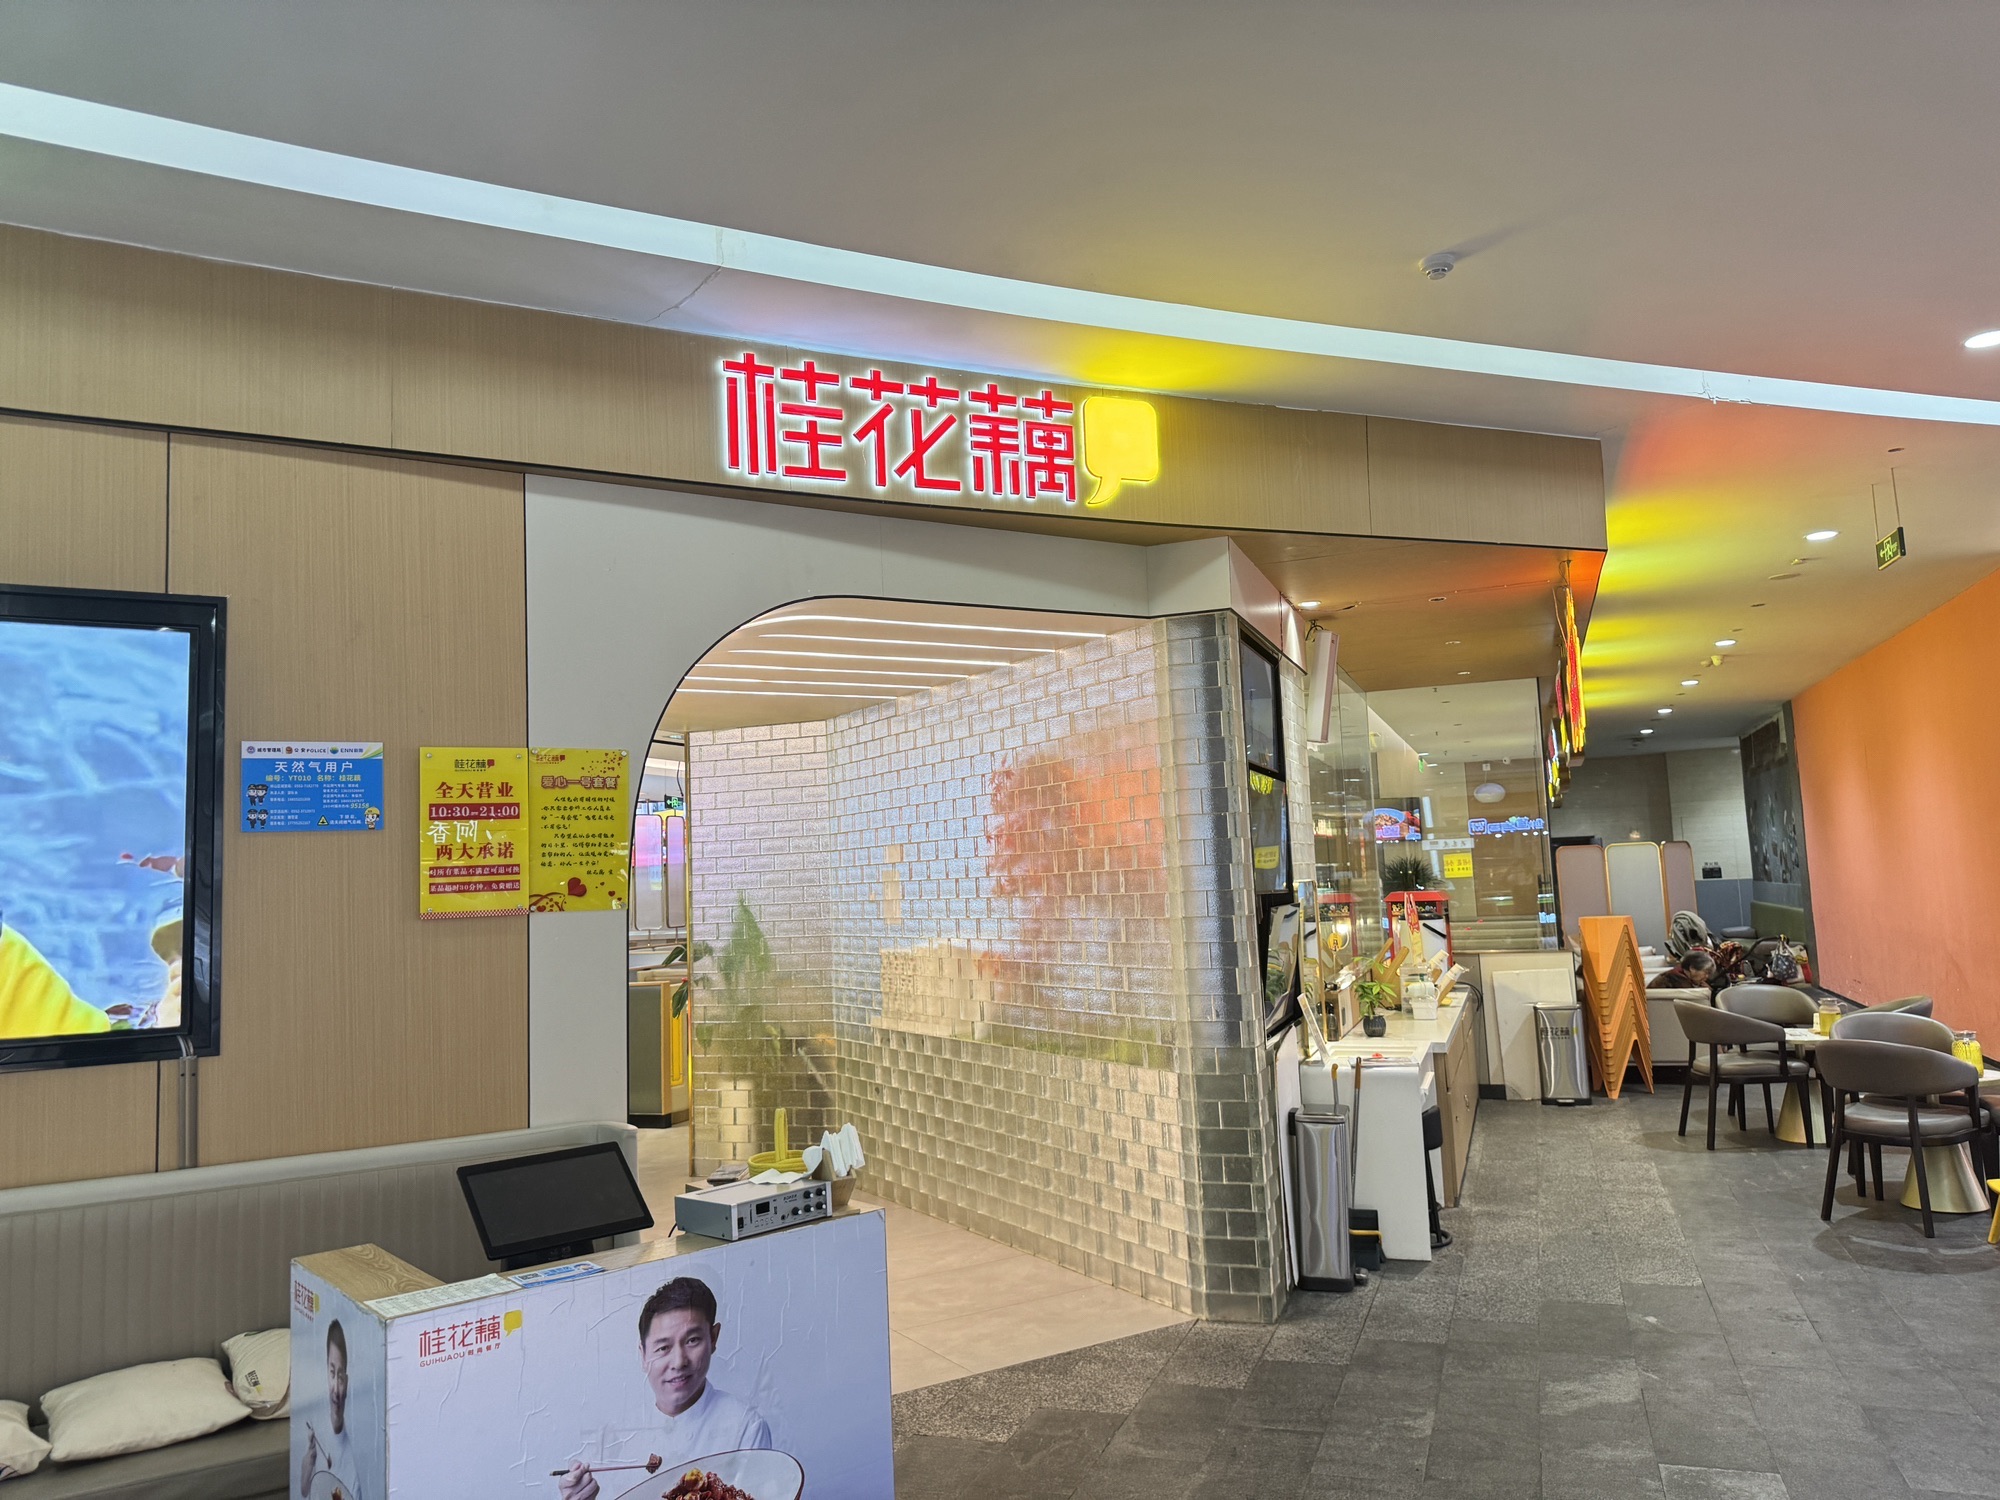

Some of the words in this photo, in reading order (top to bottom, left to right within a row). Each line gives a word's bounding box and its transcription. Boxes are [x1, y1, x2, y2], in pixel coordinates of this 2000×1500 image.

[722, 352, 1077, 503] 桂花藕
[274, 761, 353, 773] 天然气用户
[454, 759, 487, 769] 桂花藕
[435, 781, 514, 799] 全天营业
[541, 775, 618, 790] 爱心一号套餐
[435, 841, 514, 861] 两大承诺
[419, 1315, 500, 1358] 桂花藕
[419, 1351, 465, 1368] GUIHUAOU
